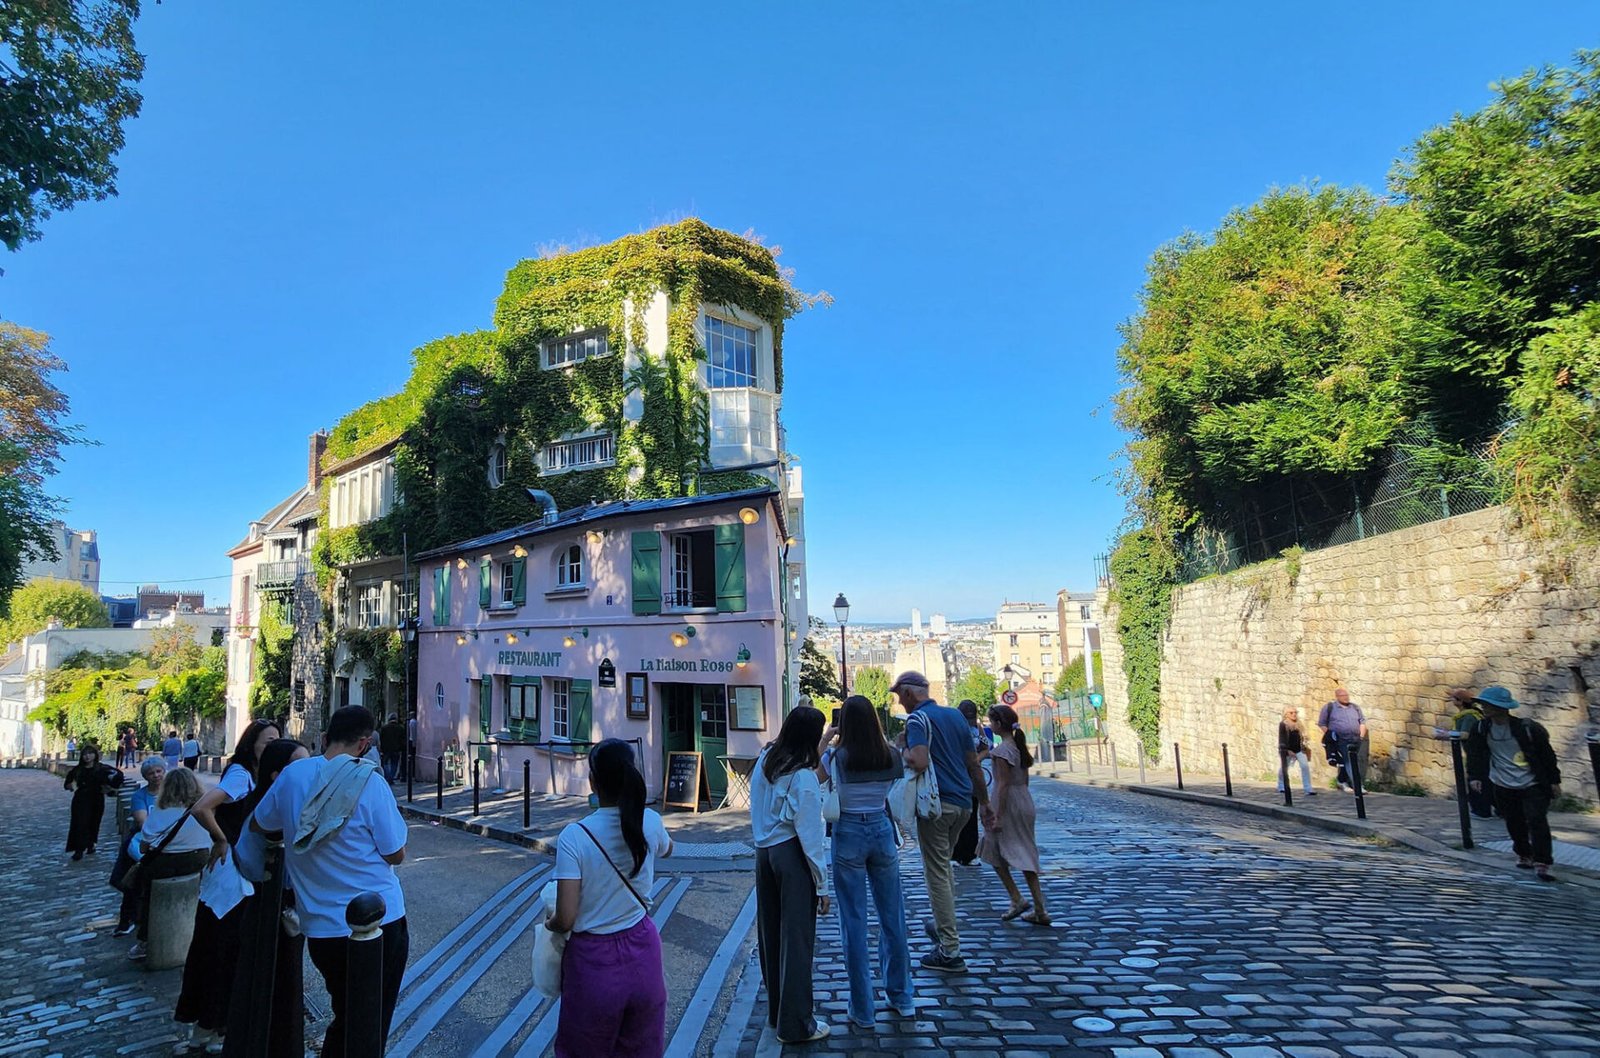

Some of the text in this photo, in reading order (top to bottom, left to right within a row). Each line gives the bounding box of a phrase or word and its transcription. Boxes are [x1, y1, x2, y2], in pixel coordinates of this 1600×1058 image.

[498, 650, 562, 667] RESTAURANT
[640, 658, 733, 673] La Maison Rose
